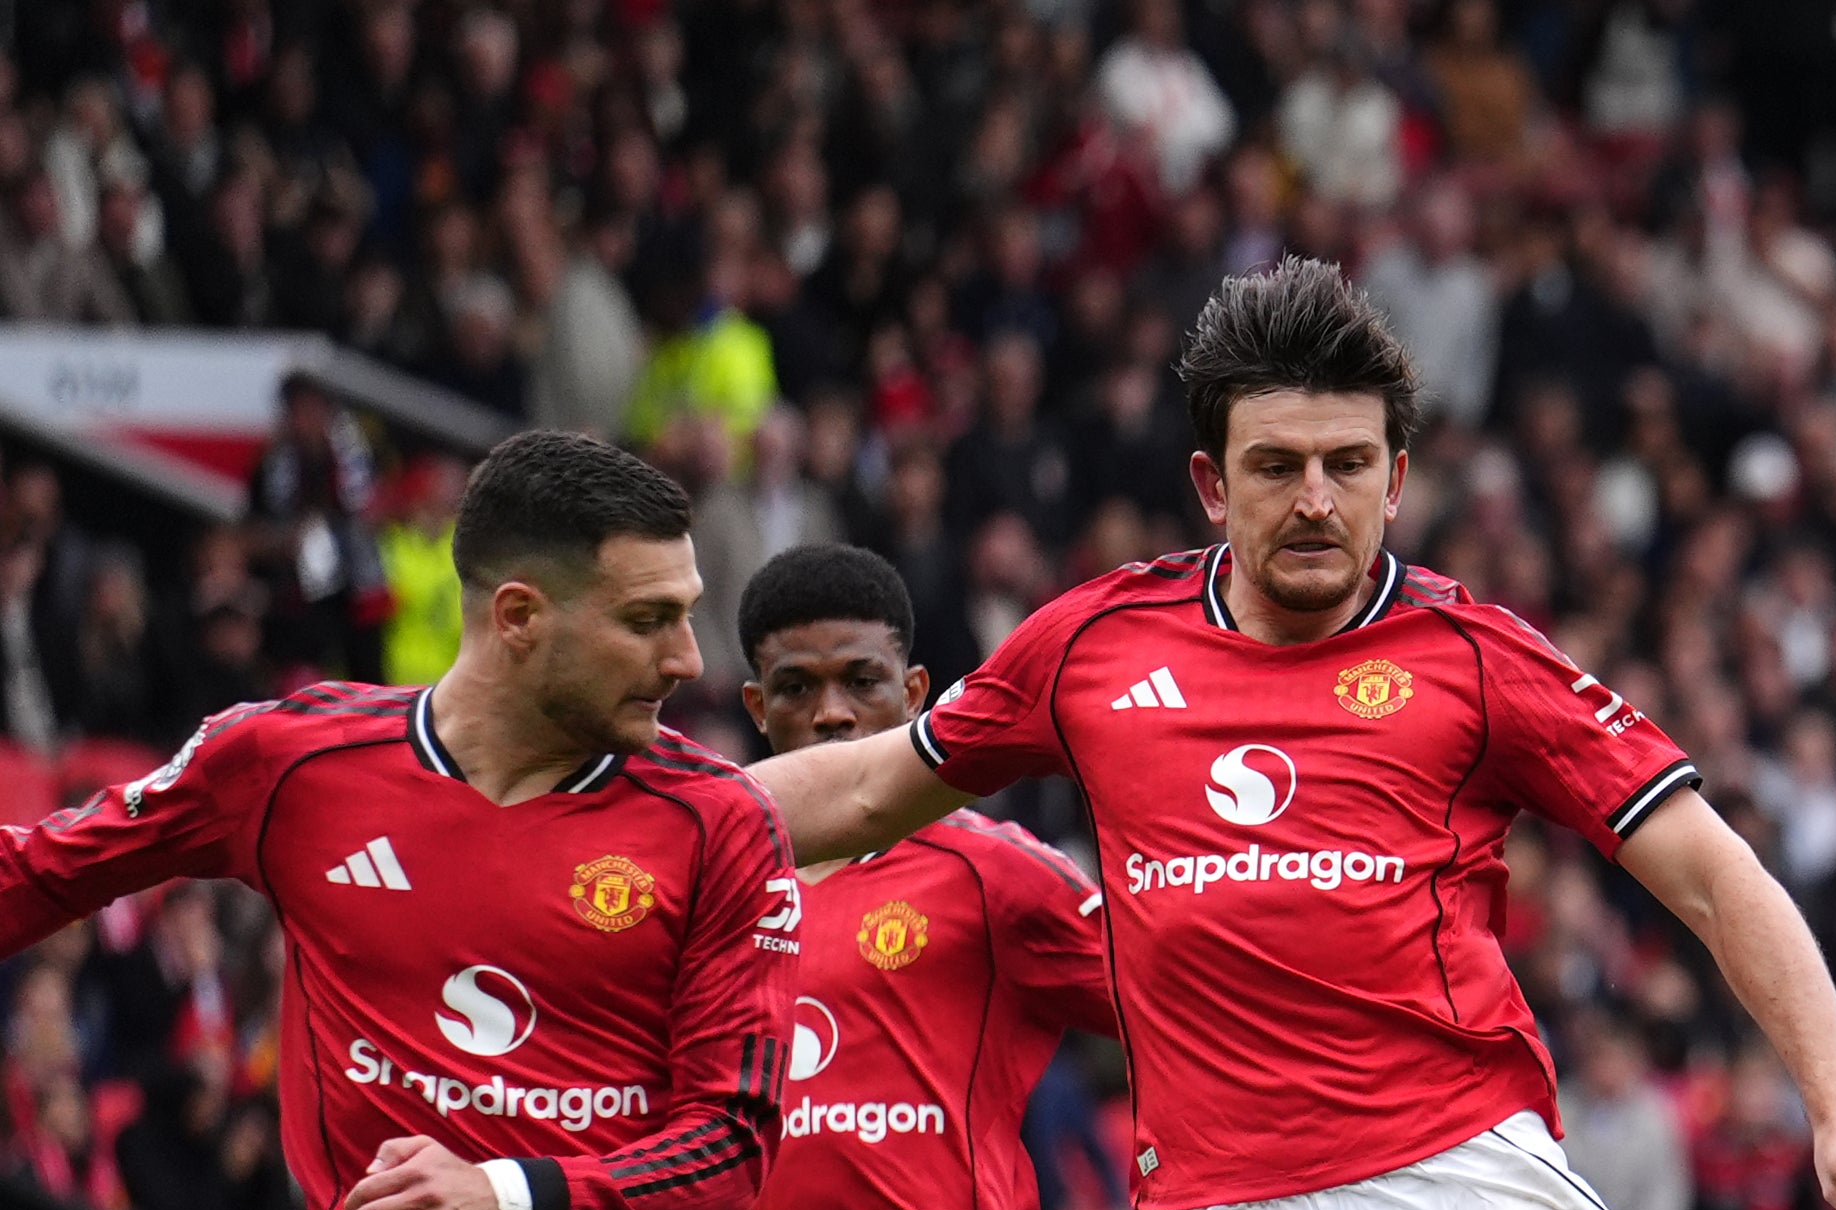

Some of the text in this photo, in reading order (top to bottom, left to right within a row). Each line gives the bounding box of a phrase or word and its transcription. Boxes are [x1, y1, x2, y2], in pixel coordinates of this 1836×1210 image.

[1349, 703, 1394, 714] UNITED
[1126, 844, 1405, 895] Snapdragon
[586, 910, 633, 926] UNITED
[780, 1095, 945, 1144] dragon
